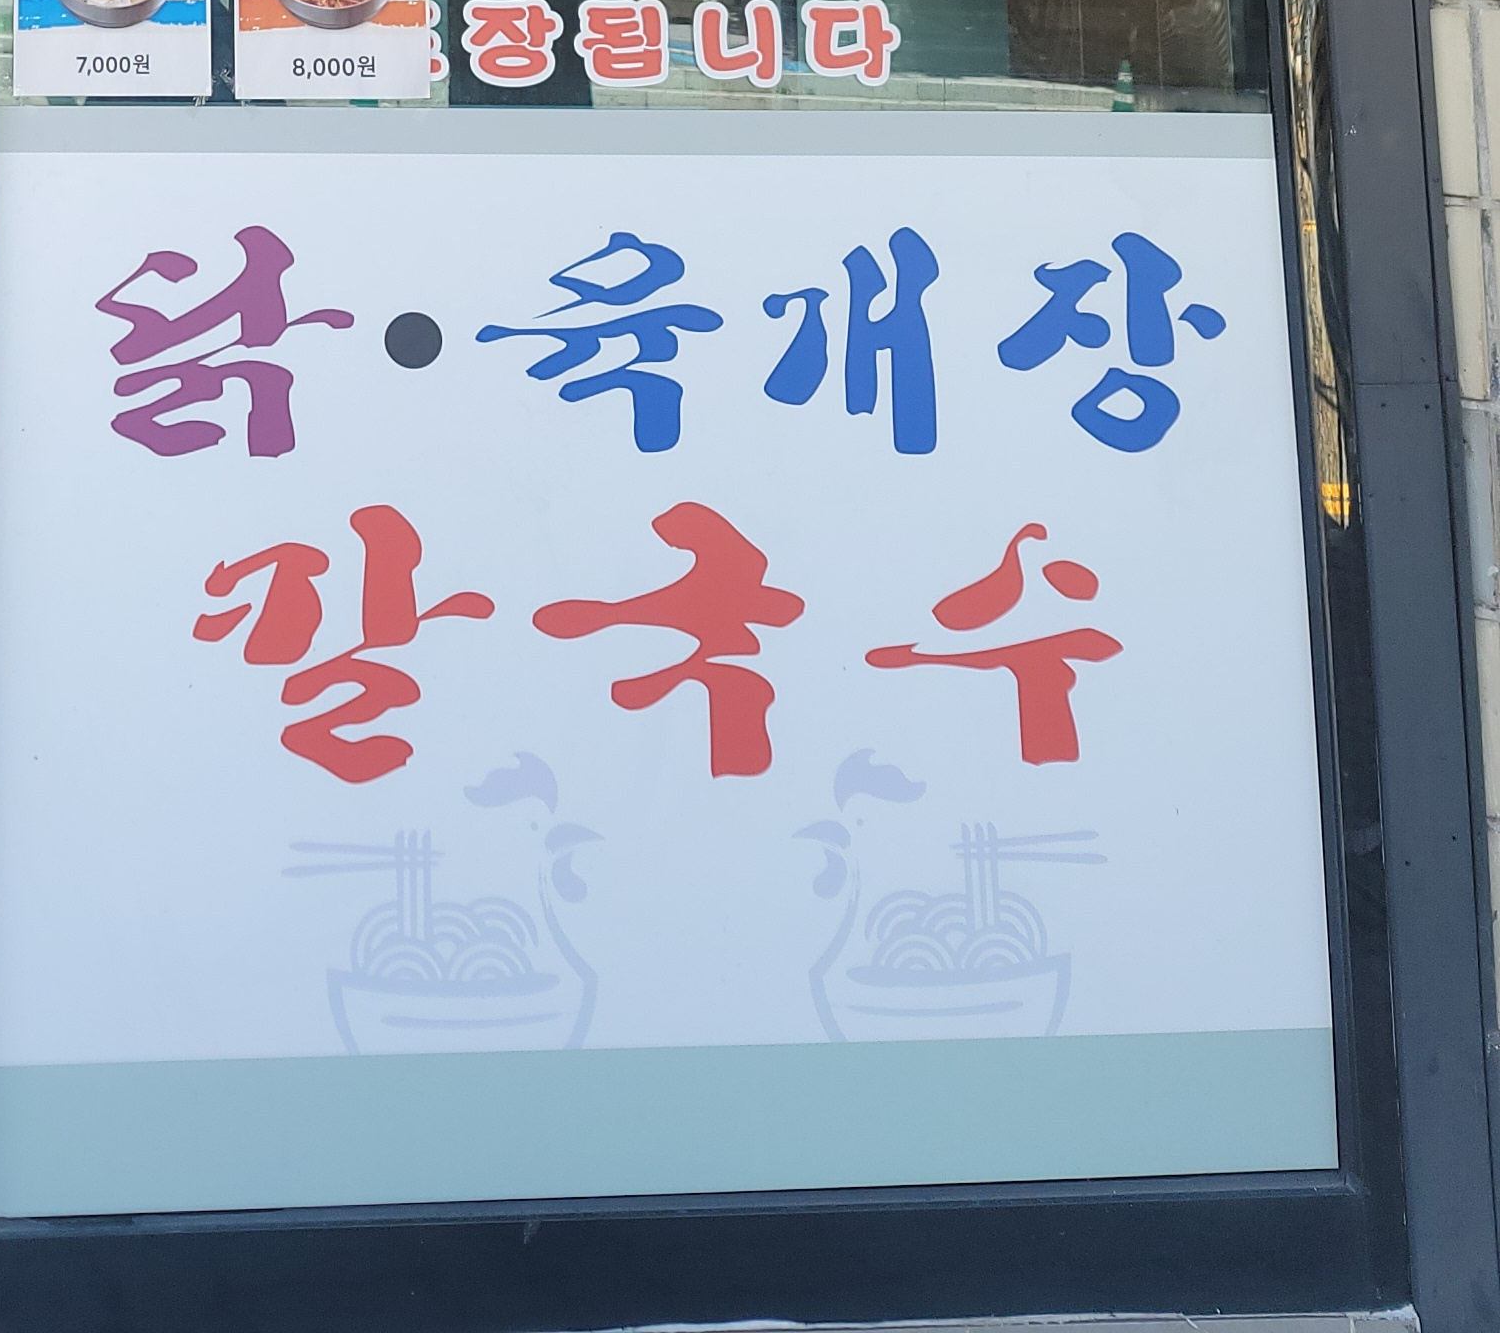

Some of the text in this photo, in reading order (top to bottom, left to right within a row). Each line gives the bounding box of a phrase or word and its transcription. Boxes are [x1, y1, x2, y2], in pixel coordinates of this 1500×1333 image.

[75, 54, 151, 76] 7,000원
[291, 55, 377, 80] 8,000원
[192, 501, 1124, 785] 칼국수
